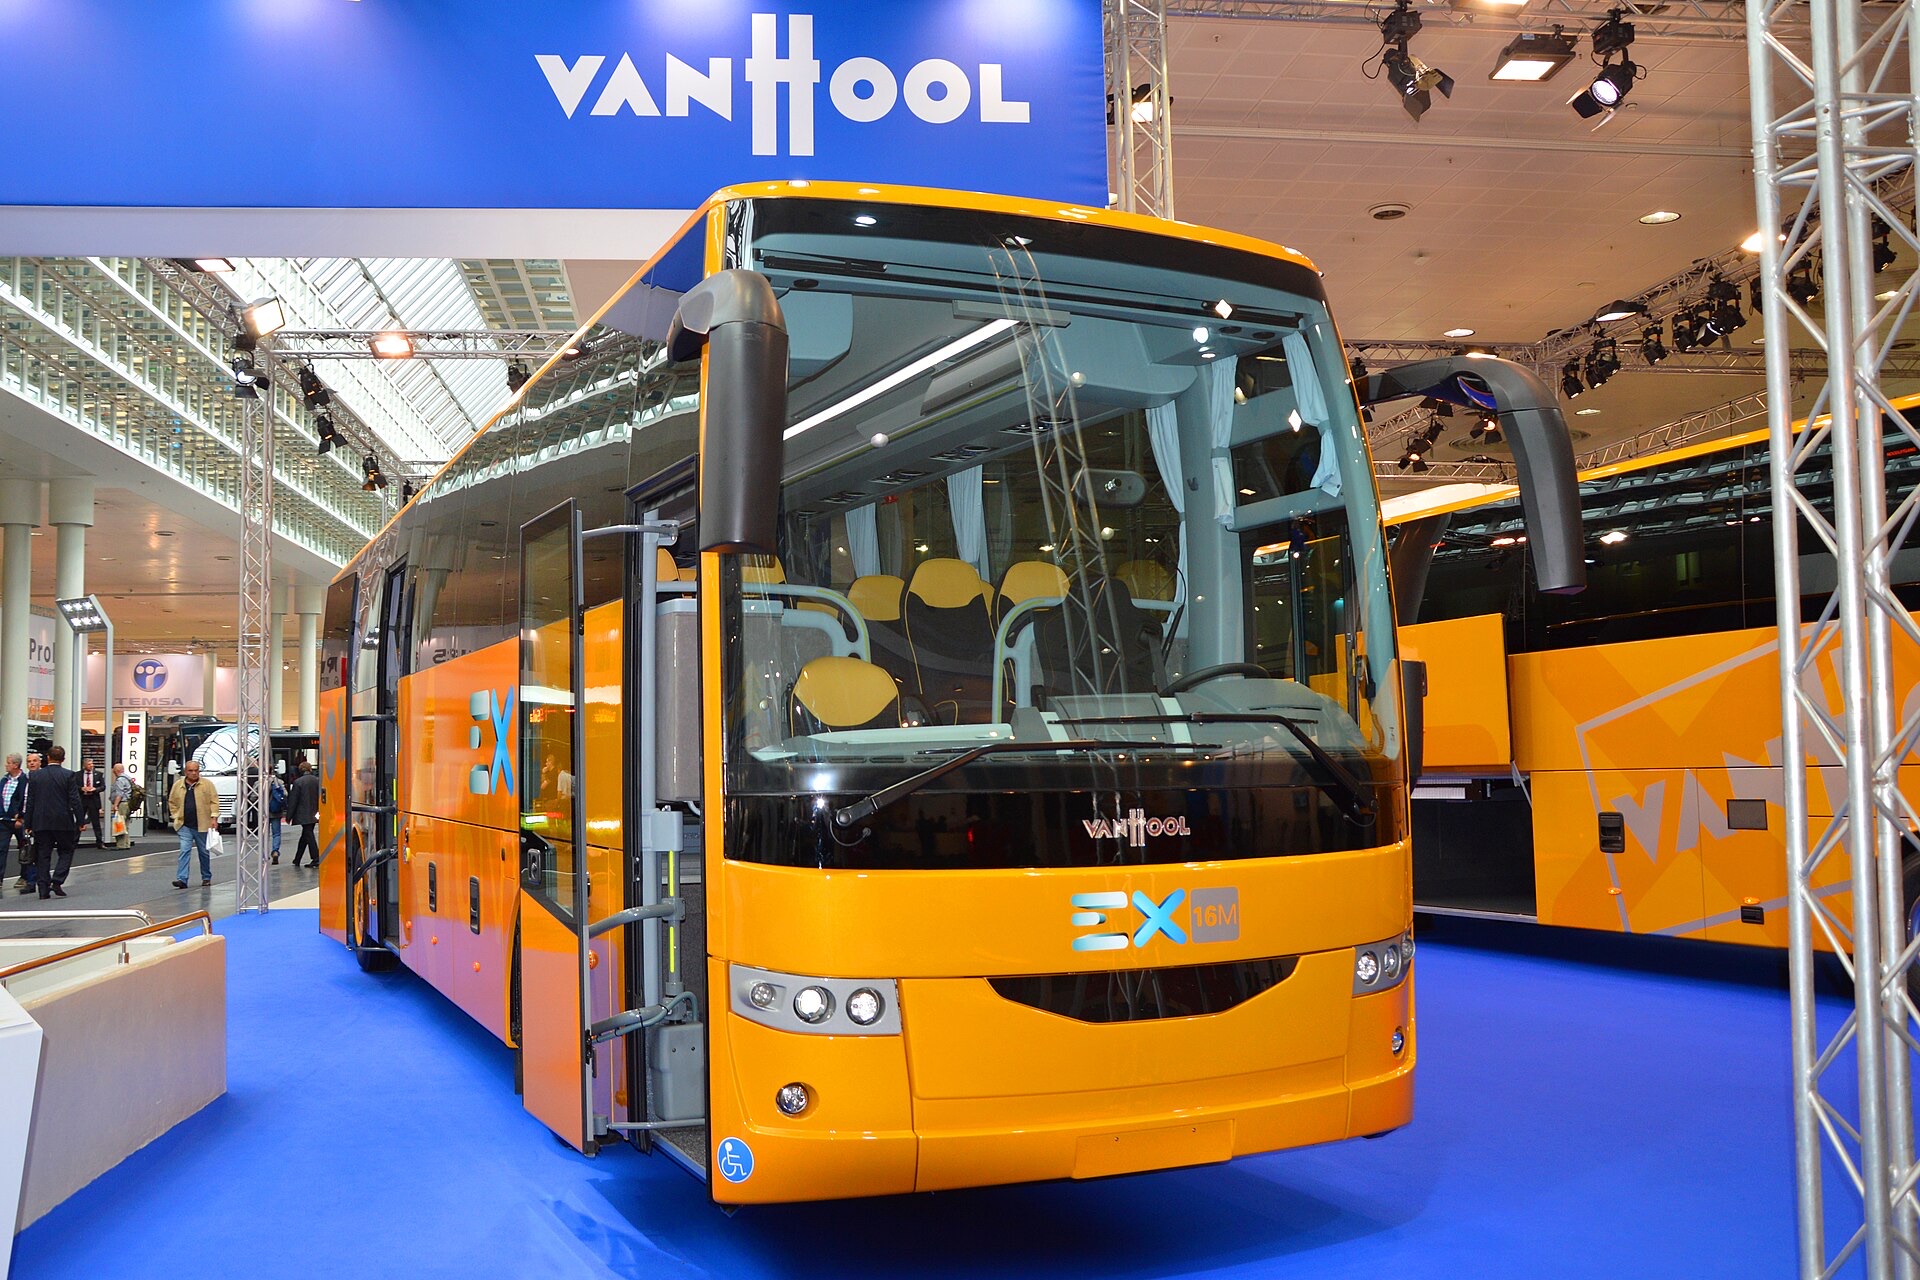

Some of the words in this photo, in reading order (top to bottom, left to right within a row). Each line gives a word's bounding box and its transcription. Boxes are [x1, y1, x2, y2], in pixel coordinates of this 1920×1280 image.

[29, 637, 55, 664] Pro
[114, 697, 184, 706] TEMSA
[469, 685, 515, 797] EX
[1071, 888, 1188, 952] EX
[1192, 903, 1238, 927] 16M
